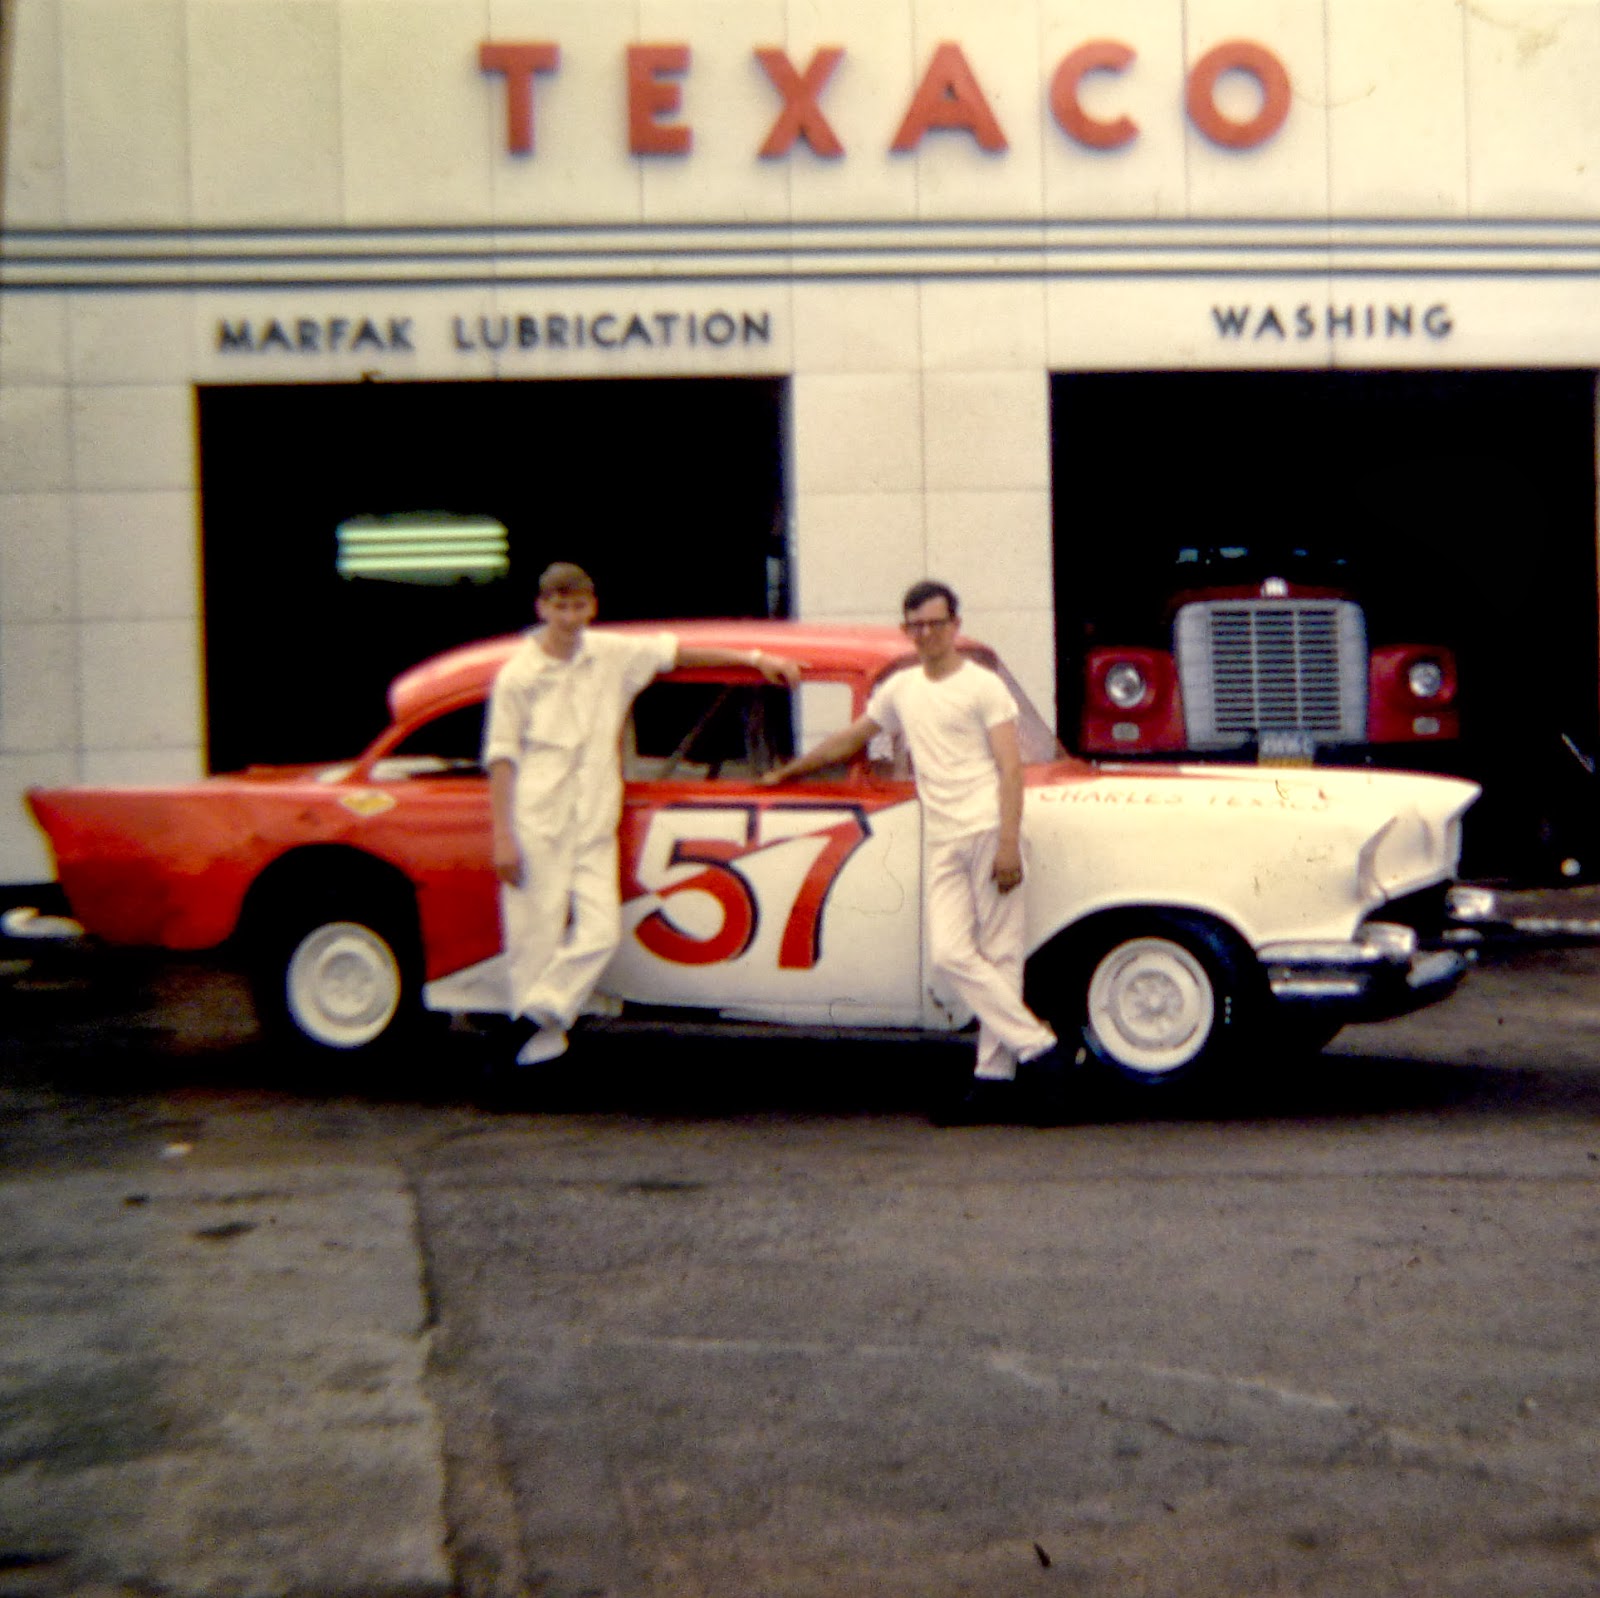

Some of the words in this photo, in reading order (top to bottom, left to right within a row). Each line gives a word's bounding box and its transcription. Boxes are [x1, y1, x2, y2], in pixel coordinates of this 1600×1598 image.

[477, 40, 1293, 160] TEXACO
[217, 314, 413, 353] MARFAK
[452, 312, 771, 350] LUBRICATION
[1211, 304, 1453, 340] WASHING
[1038, 787, 1183, 806] CHARLES
[634, 803, 873, 970] 57
